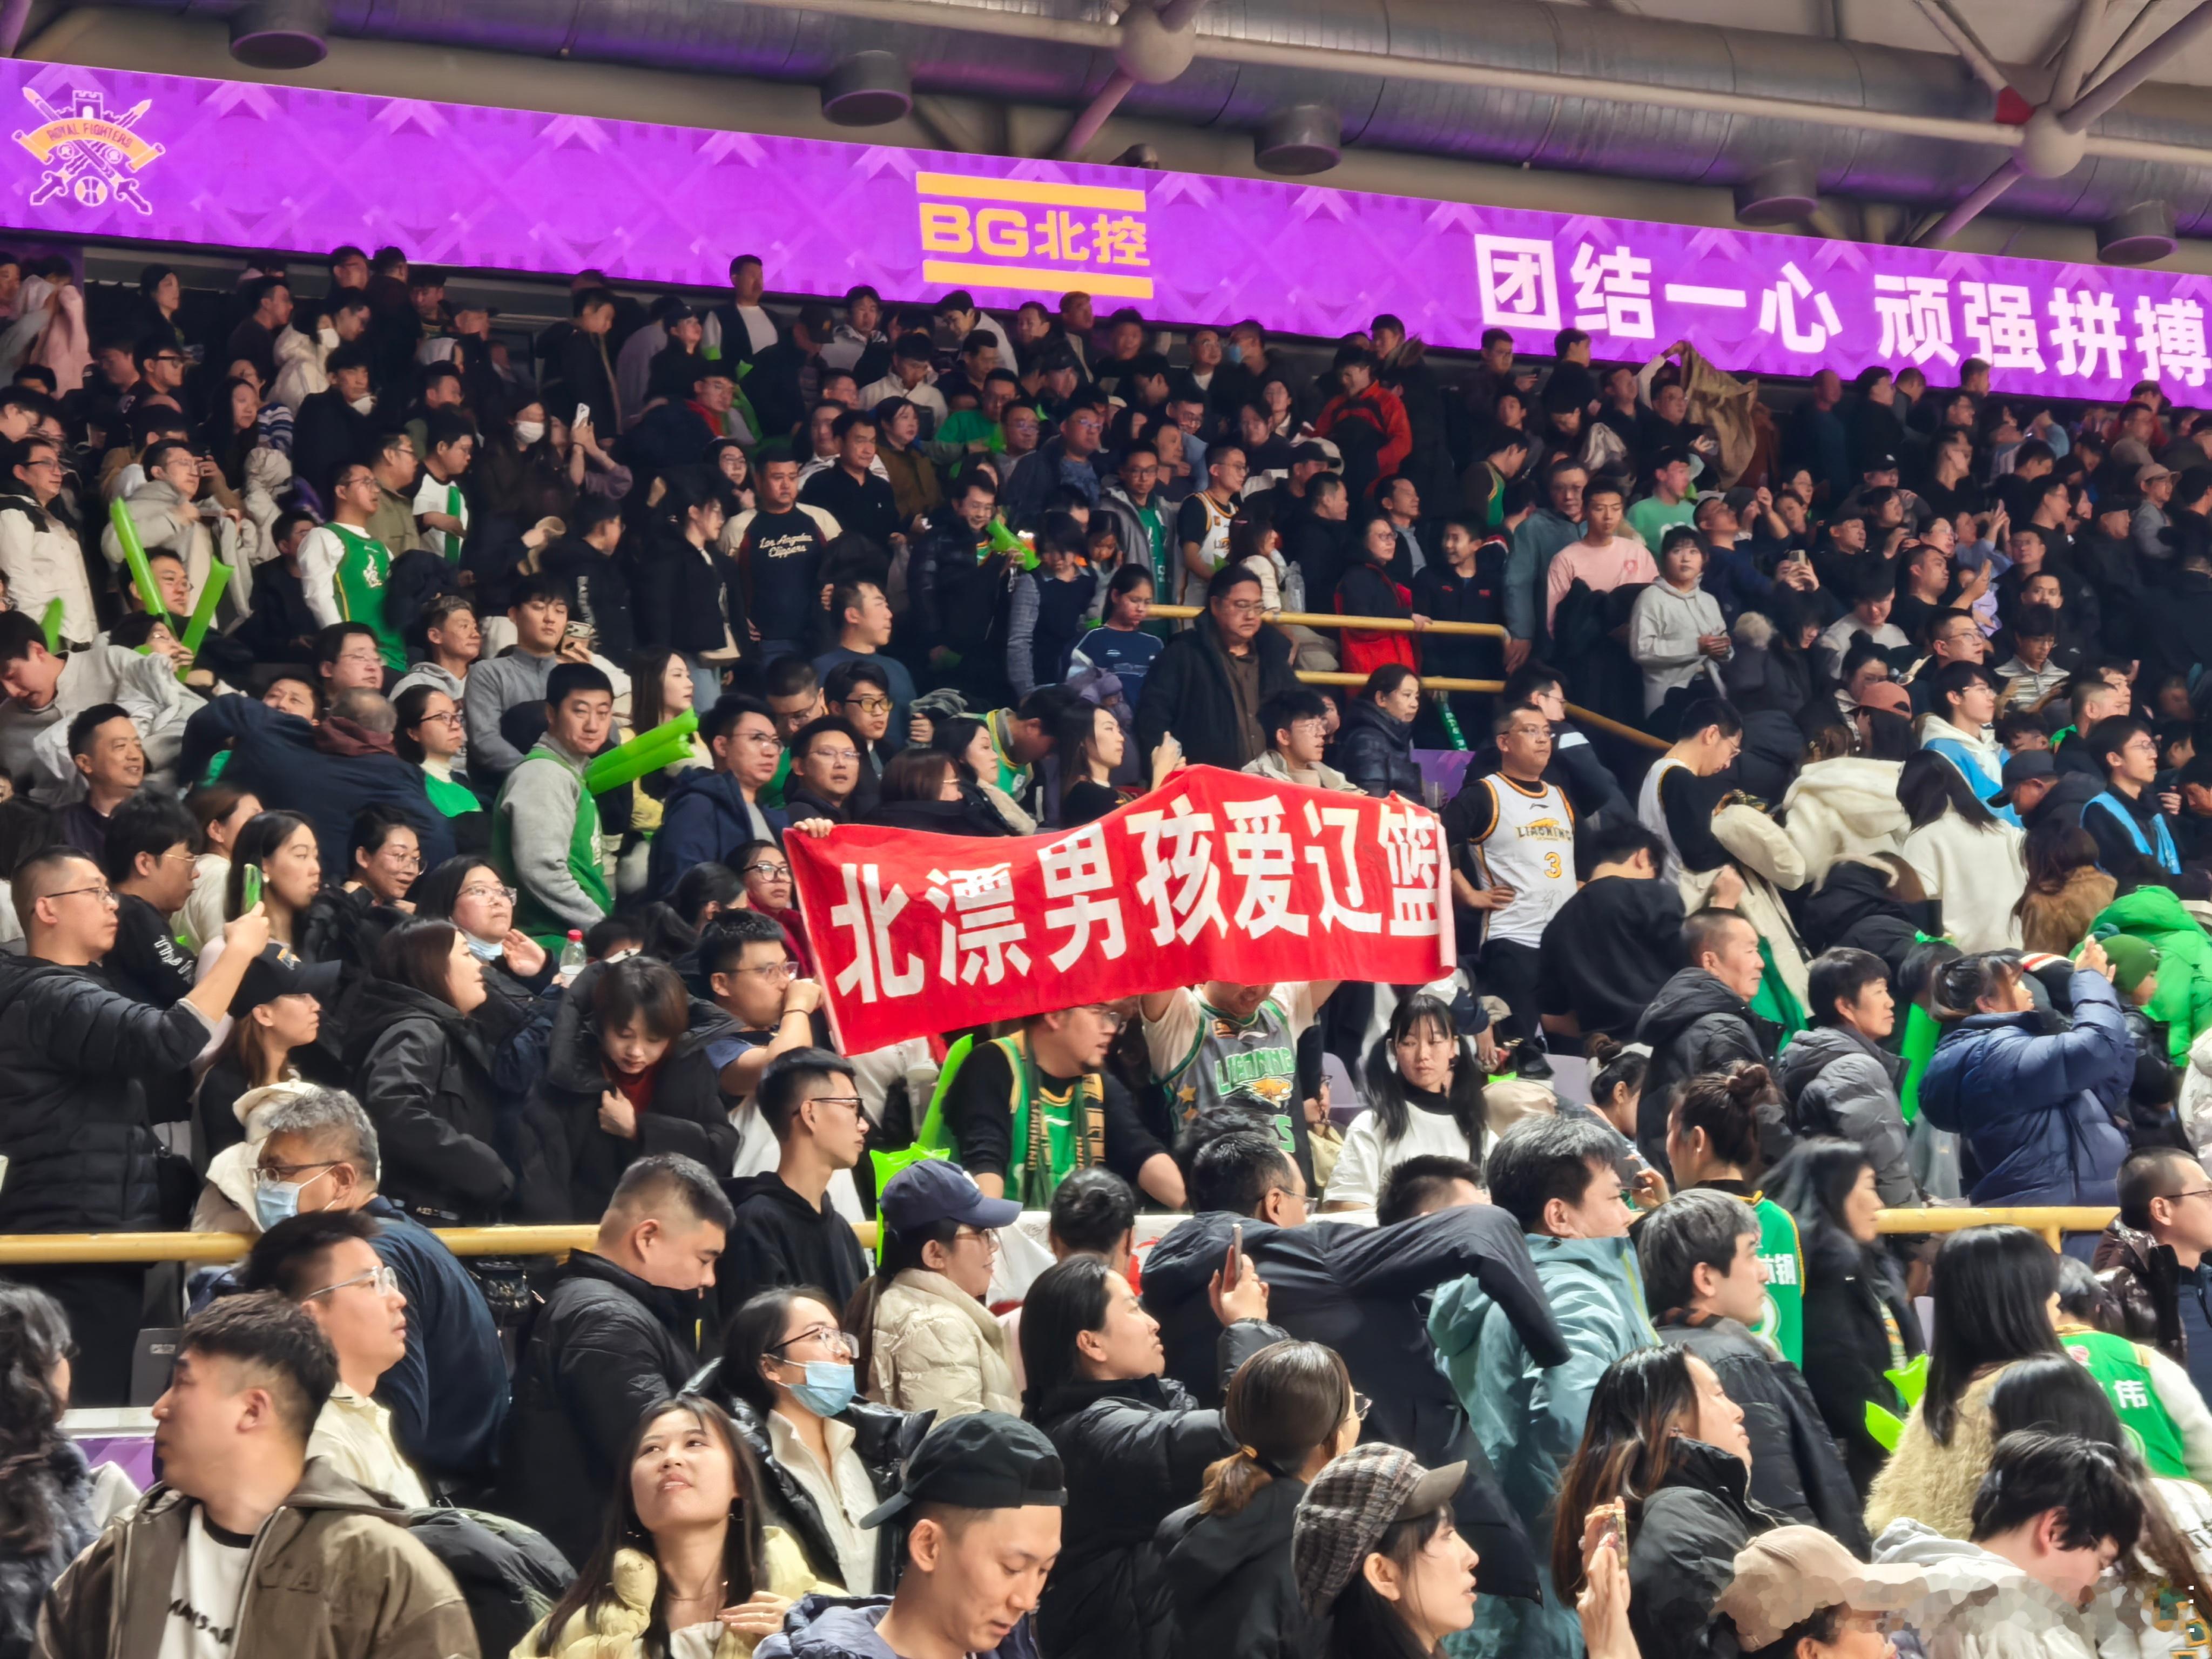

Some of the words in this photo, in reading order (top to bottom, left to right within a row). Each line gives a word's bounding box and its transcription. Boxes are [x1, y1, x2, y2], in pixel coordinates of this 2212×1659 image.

[46, 123, 80, 141] ROYAL
[920, 203, 1150, 266] BG北控
[1474, 233, 1842, 354] 团结一心
[1874, 273, 2212, 386] 顽强拼搏
[1545, 852, 1562, 878] 3
[831, 794, 1440, 1003] 北漂男孩爱辽篮
[2101, 1379, 2149, 1408] 伟
